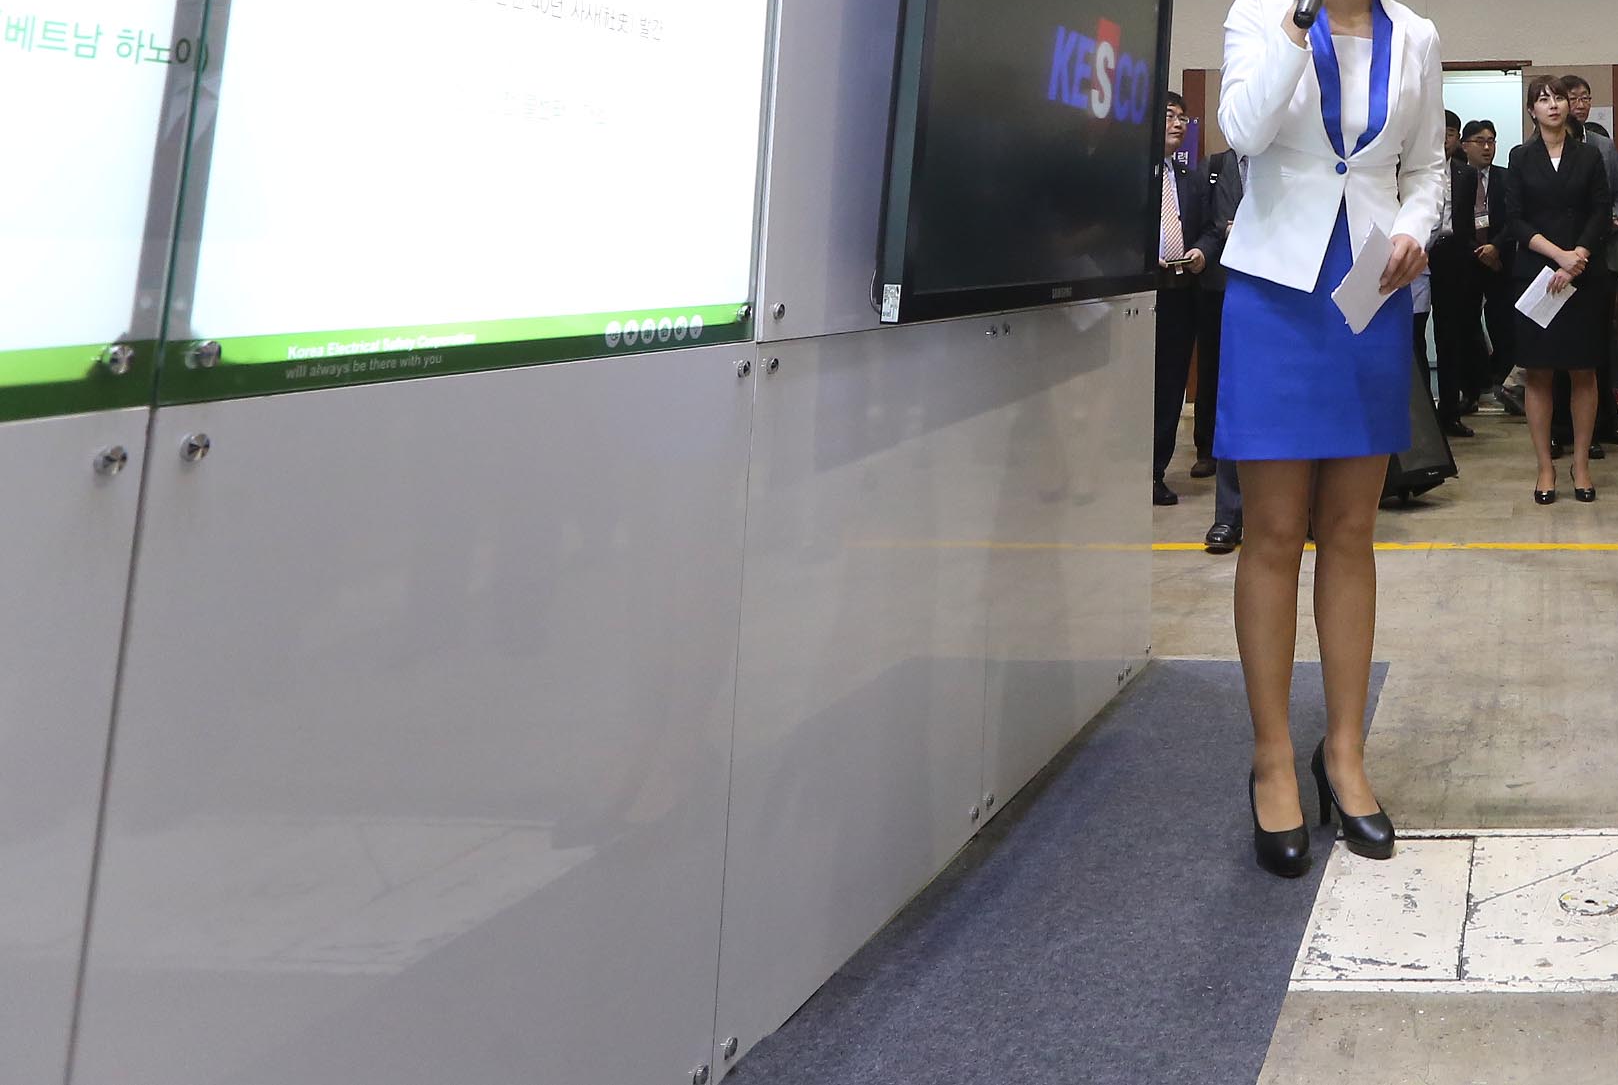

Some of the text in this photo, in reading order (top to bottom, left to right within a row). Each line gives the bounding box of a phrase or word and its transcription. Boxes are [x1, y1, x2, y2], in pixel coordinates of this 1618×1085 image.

[1048, 25, 1149, 124] KESCO
[288, 346, 324, 360] Korea
[286, 355, 443, 379] will always be there with you
